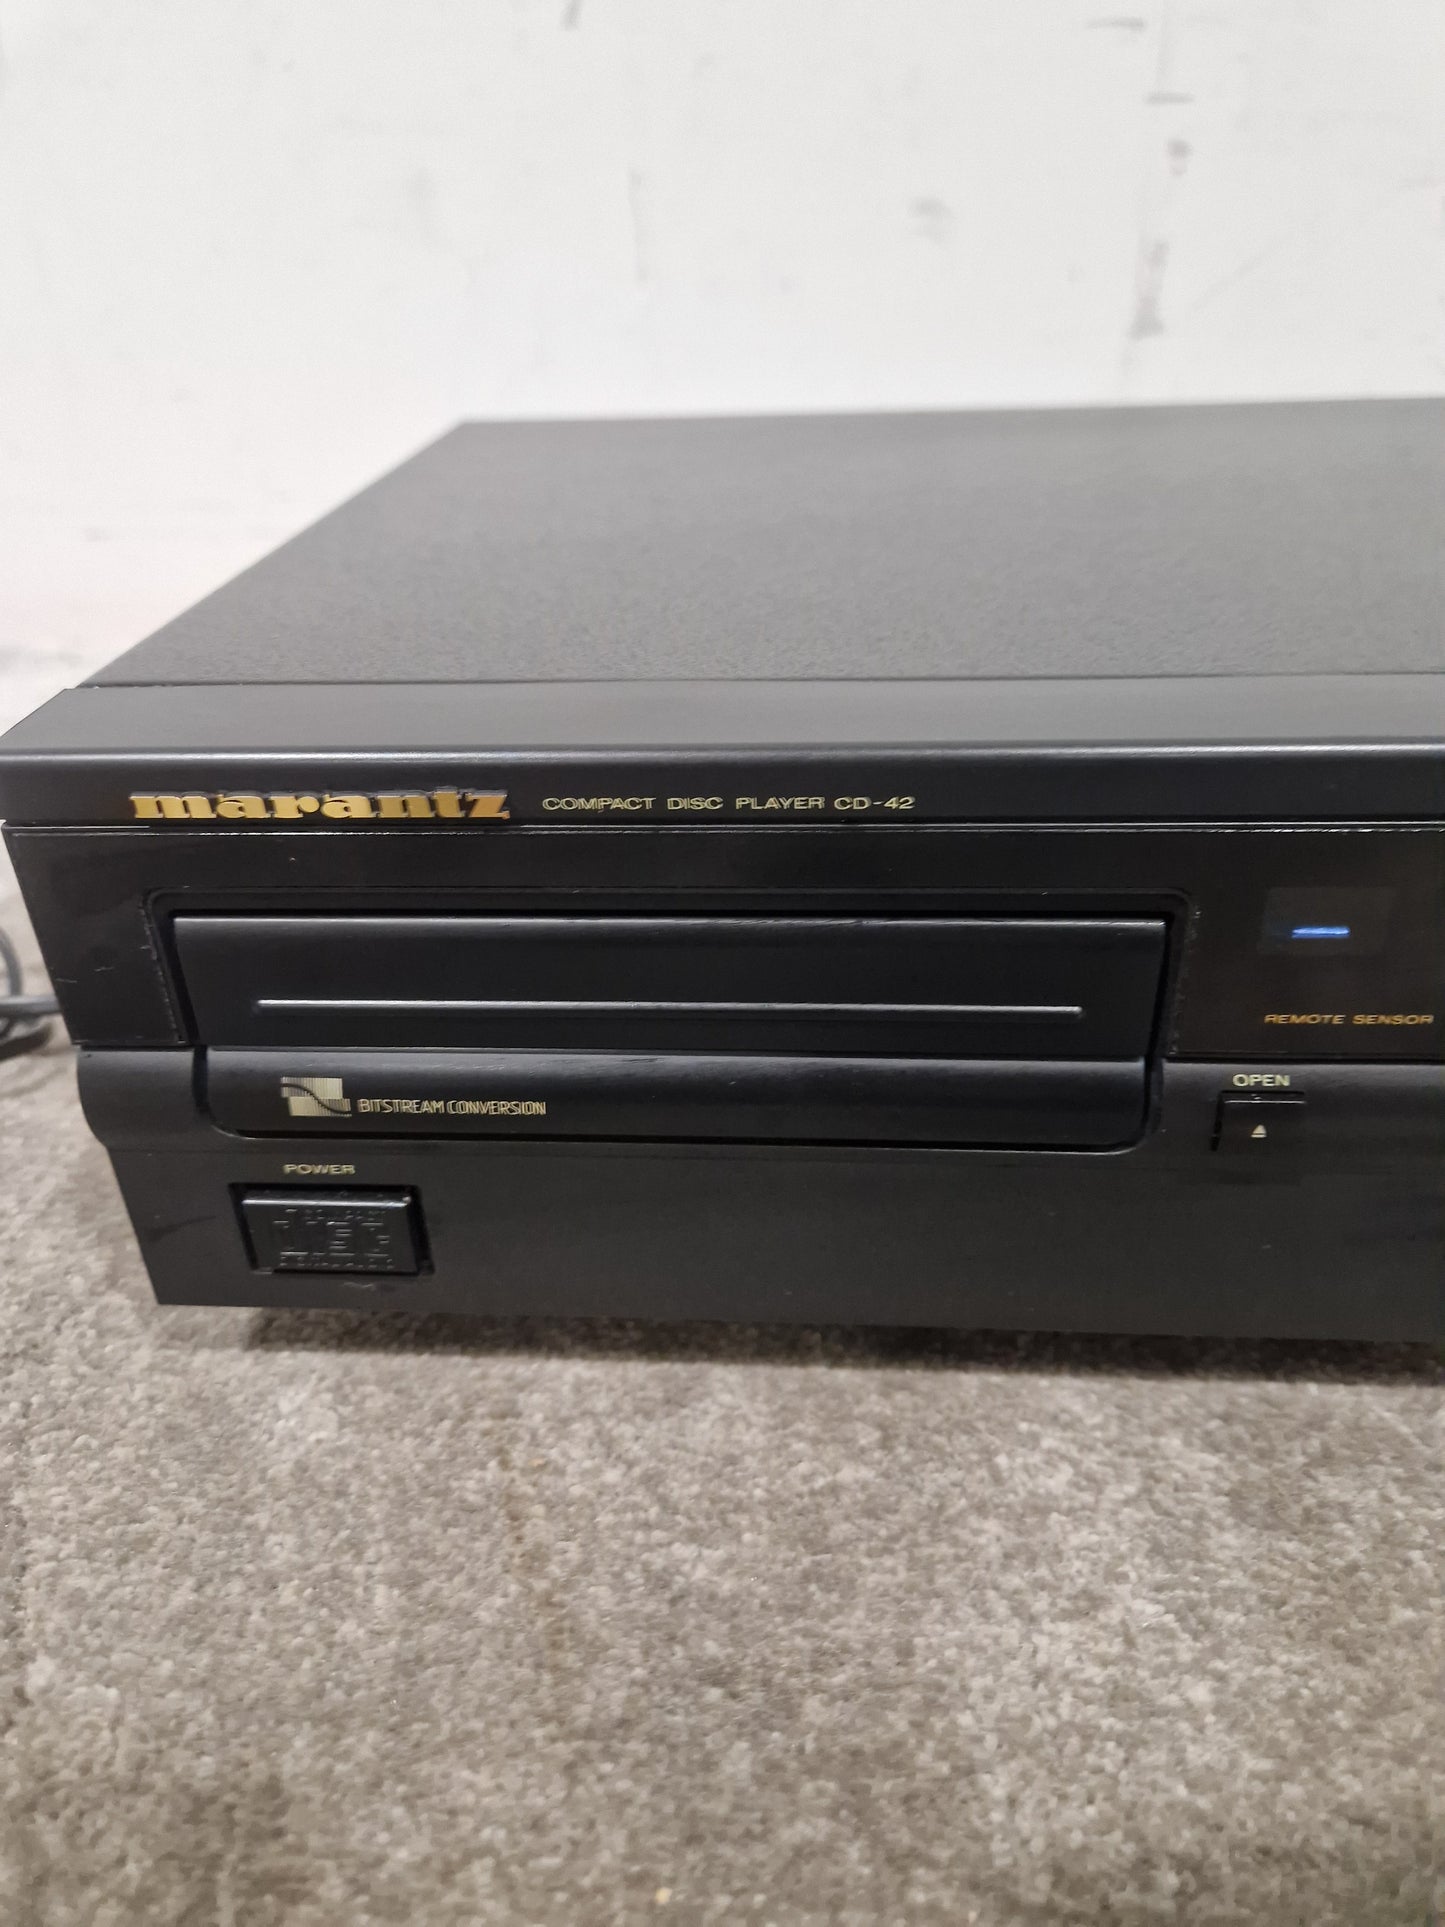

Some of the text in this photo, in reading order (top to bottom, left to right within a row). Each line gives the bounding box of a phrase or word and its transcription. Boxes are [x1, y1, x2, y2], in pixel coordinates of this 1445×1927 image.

[129, 785, 511, 820] marantz
[541, 796, 916, 811] COMPACT DISC PLAYER CD-42
[1264, 1013, 1435, 1025] REMOTE SENSOR
[1232, 1073, 1292, 1088] OPEN
[357, 1098, 547, 1116] BITSTREAM CONVERSION
[282, 1163, 356, 1175] POWER
